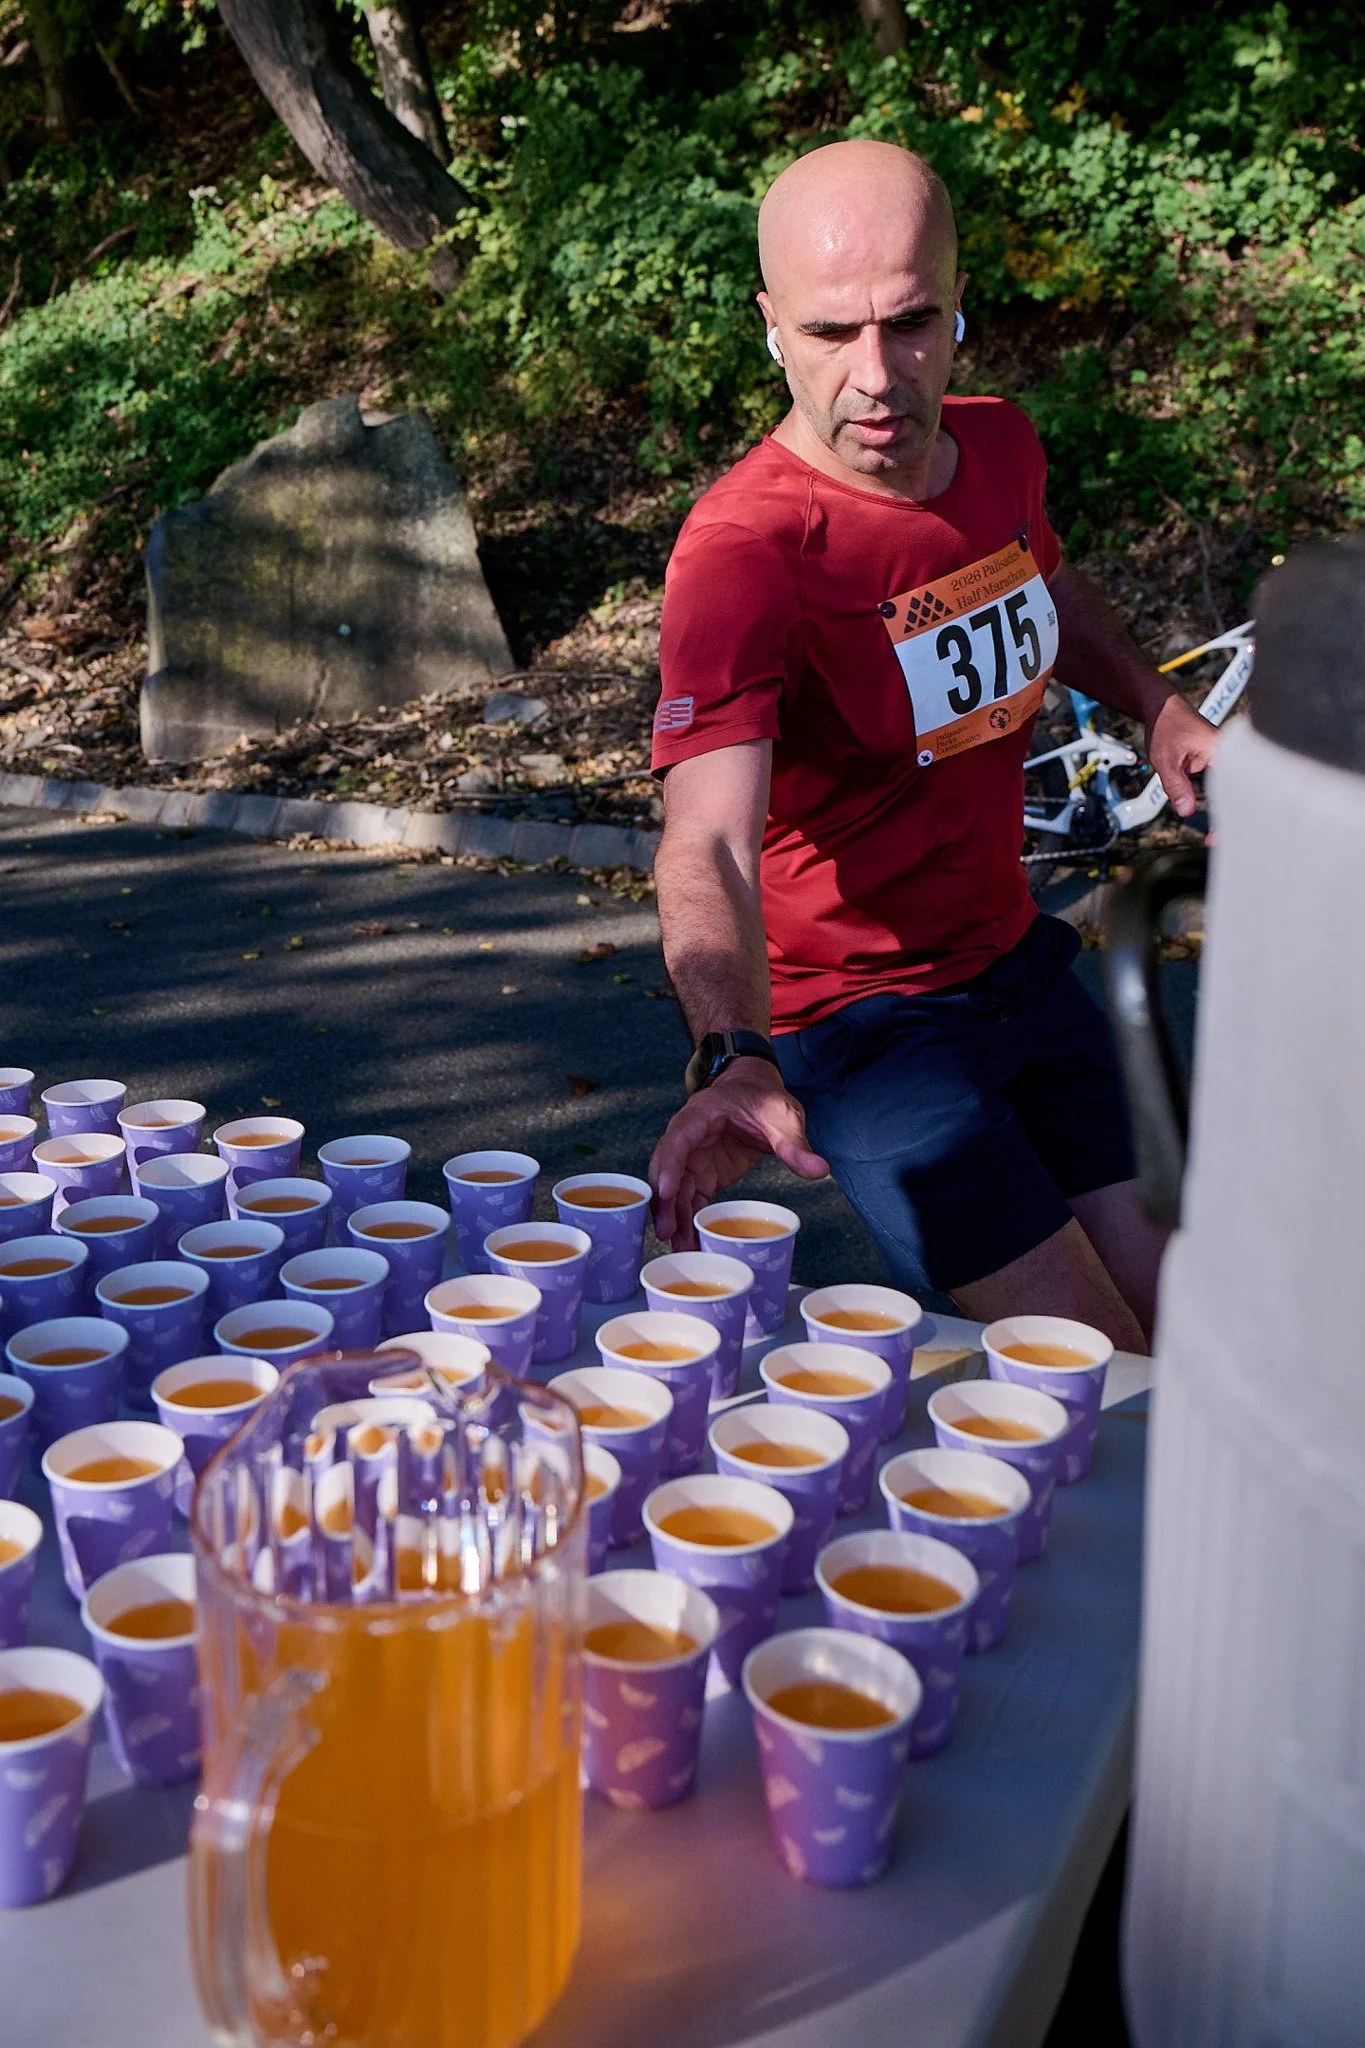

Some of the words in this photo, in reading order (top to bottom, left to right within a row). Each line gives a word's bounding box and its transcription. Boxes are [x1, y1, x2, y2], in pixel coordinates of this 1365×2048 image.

[951, 572, 981, 592] 2026
[983, 551, 1021, 579] Palisades
[956, 587, 981, 610] Half
[982, 567, 1027, 598] Marathon
[936, 590, 1042, 716] 375
